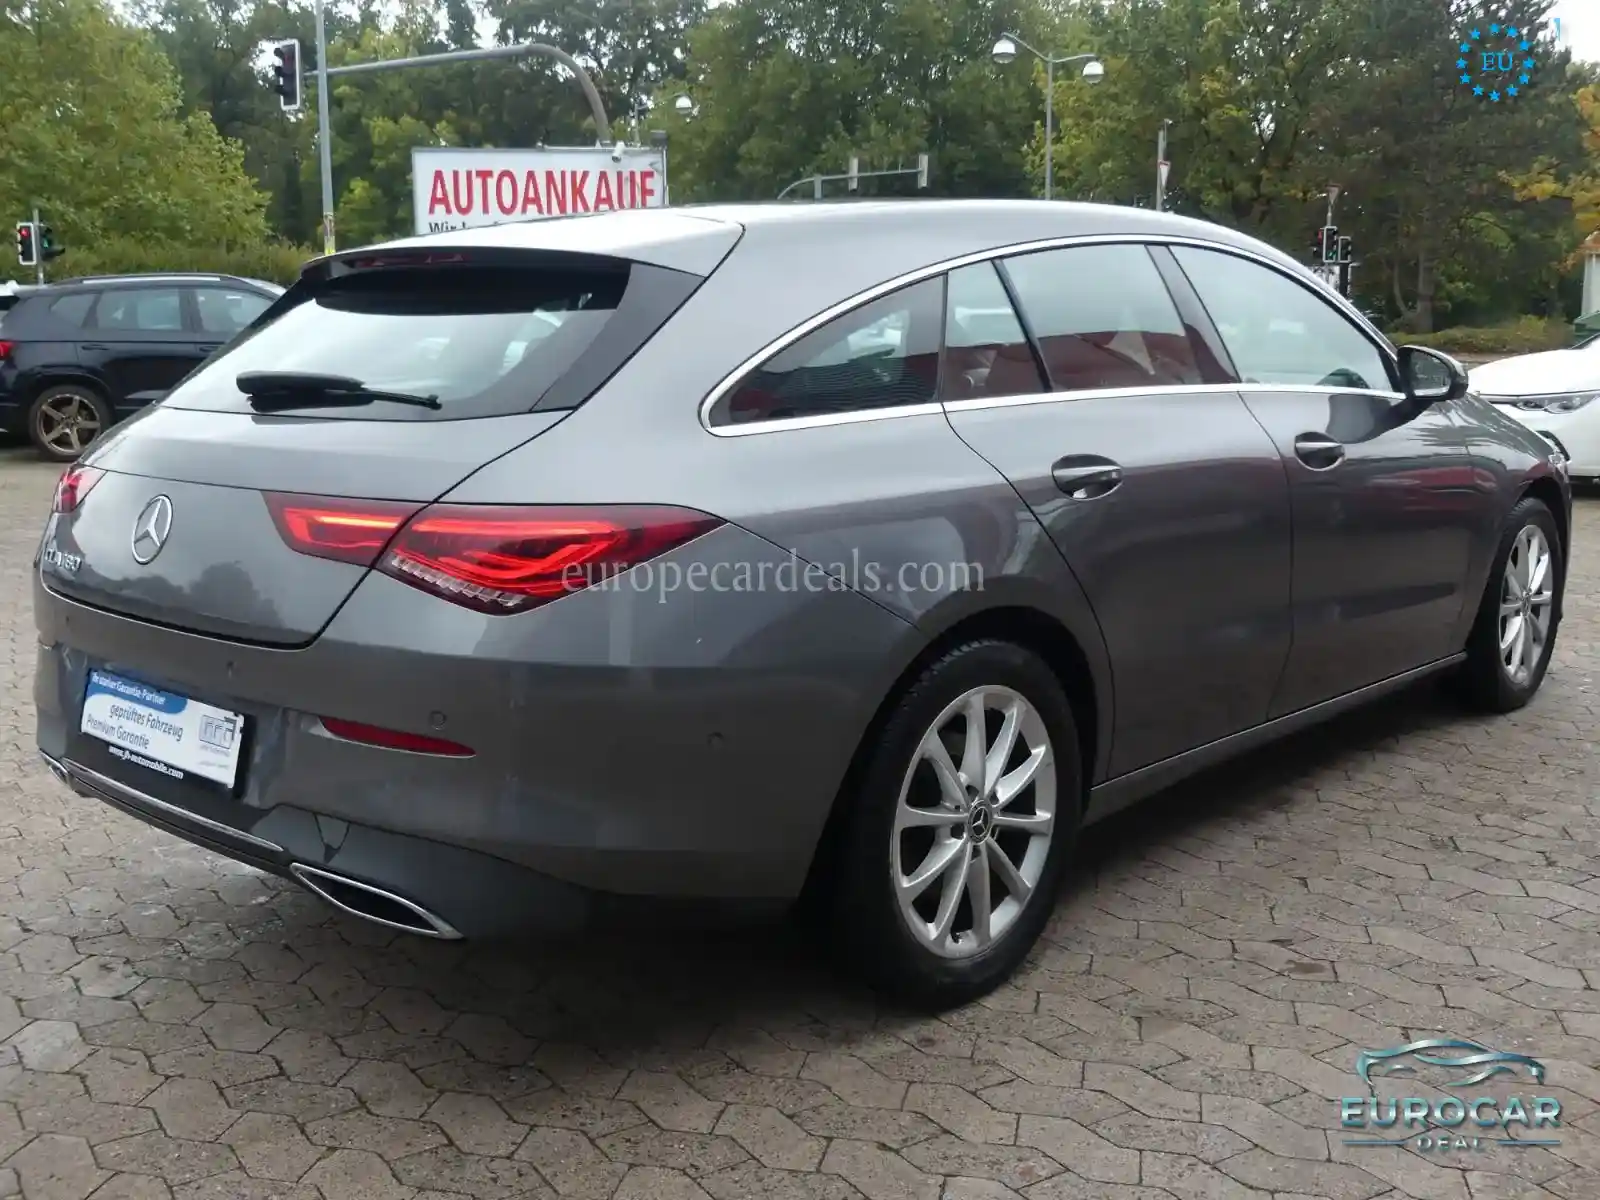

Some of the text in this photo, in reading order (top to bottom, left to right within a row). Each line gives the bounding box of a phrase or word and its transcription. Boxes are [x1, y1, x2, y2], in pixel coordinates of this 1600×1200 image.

[428, 169, 655, 216] AUTOANKAUF
[86, 713, 150, 750] Premium Garantie
[110, 703, 145, 726] geprüftes
[145, 713, 184, 742] Fahrzeug
